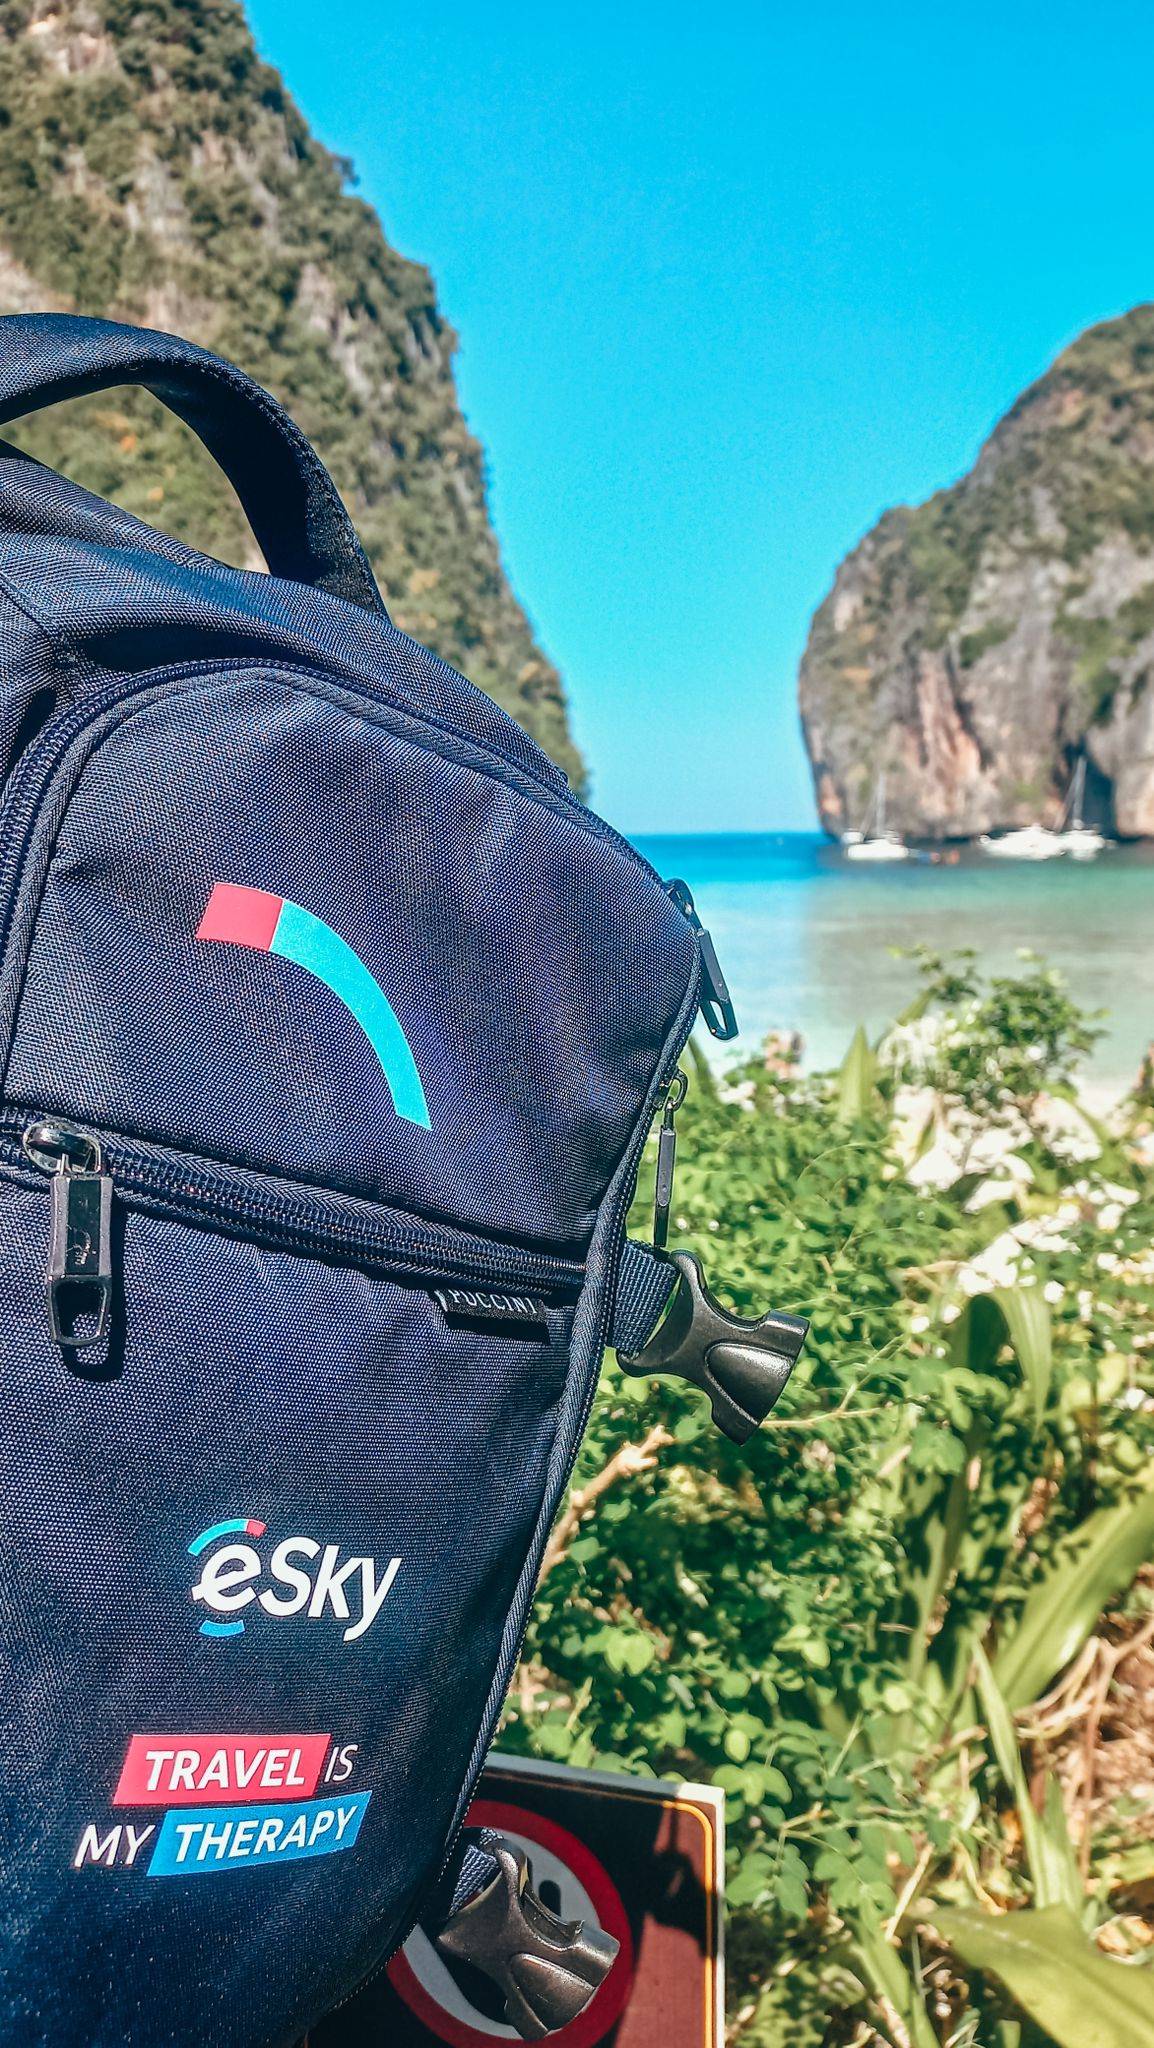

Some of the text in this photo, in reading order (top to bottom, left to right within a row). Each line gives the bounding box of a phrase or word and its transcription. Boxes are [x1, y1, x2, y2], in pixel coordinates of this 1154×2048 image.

[449, 1289, 537, 1314] PUCCINI
[191, 1536, 402, 1642] eSky
[145, 1744, 358, 1791] TRAVEL IS
[74, 1806, 357, 1867] MY THERAPY
